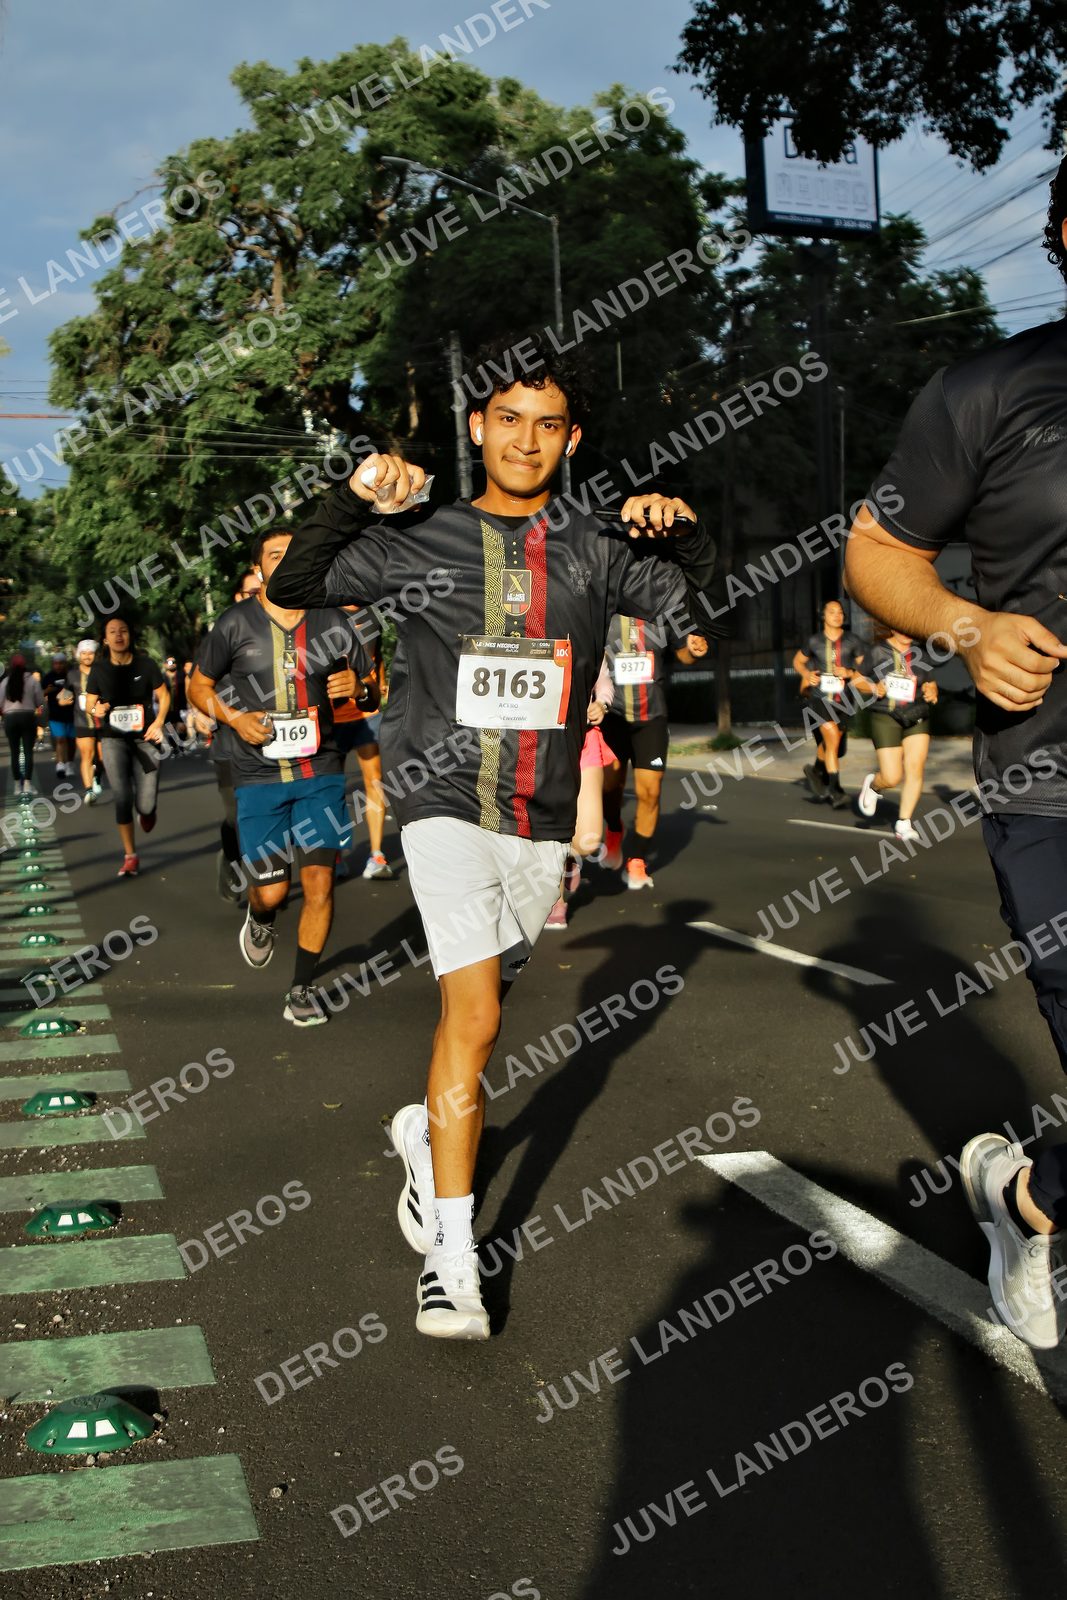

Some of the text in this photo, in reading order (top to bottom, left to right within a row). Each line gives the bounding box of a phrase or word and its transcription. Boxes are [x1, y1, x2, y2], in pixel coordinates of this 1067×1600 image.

[556, 649, 569, 657] 10K
[621, 661, 645, 672] 9377
[472, 667, 546, 699] 8163
[113, 713, 139, 722] 10913
[275, 725, 307, 742] 169
